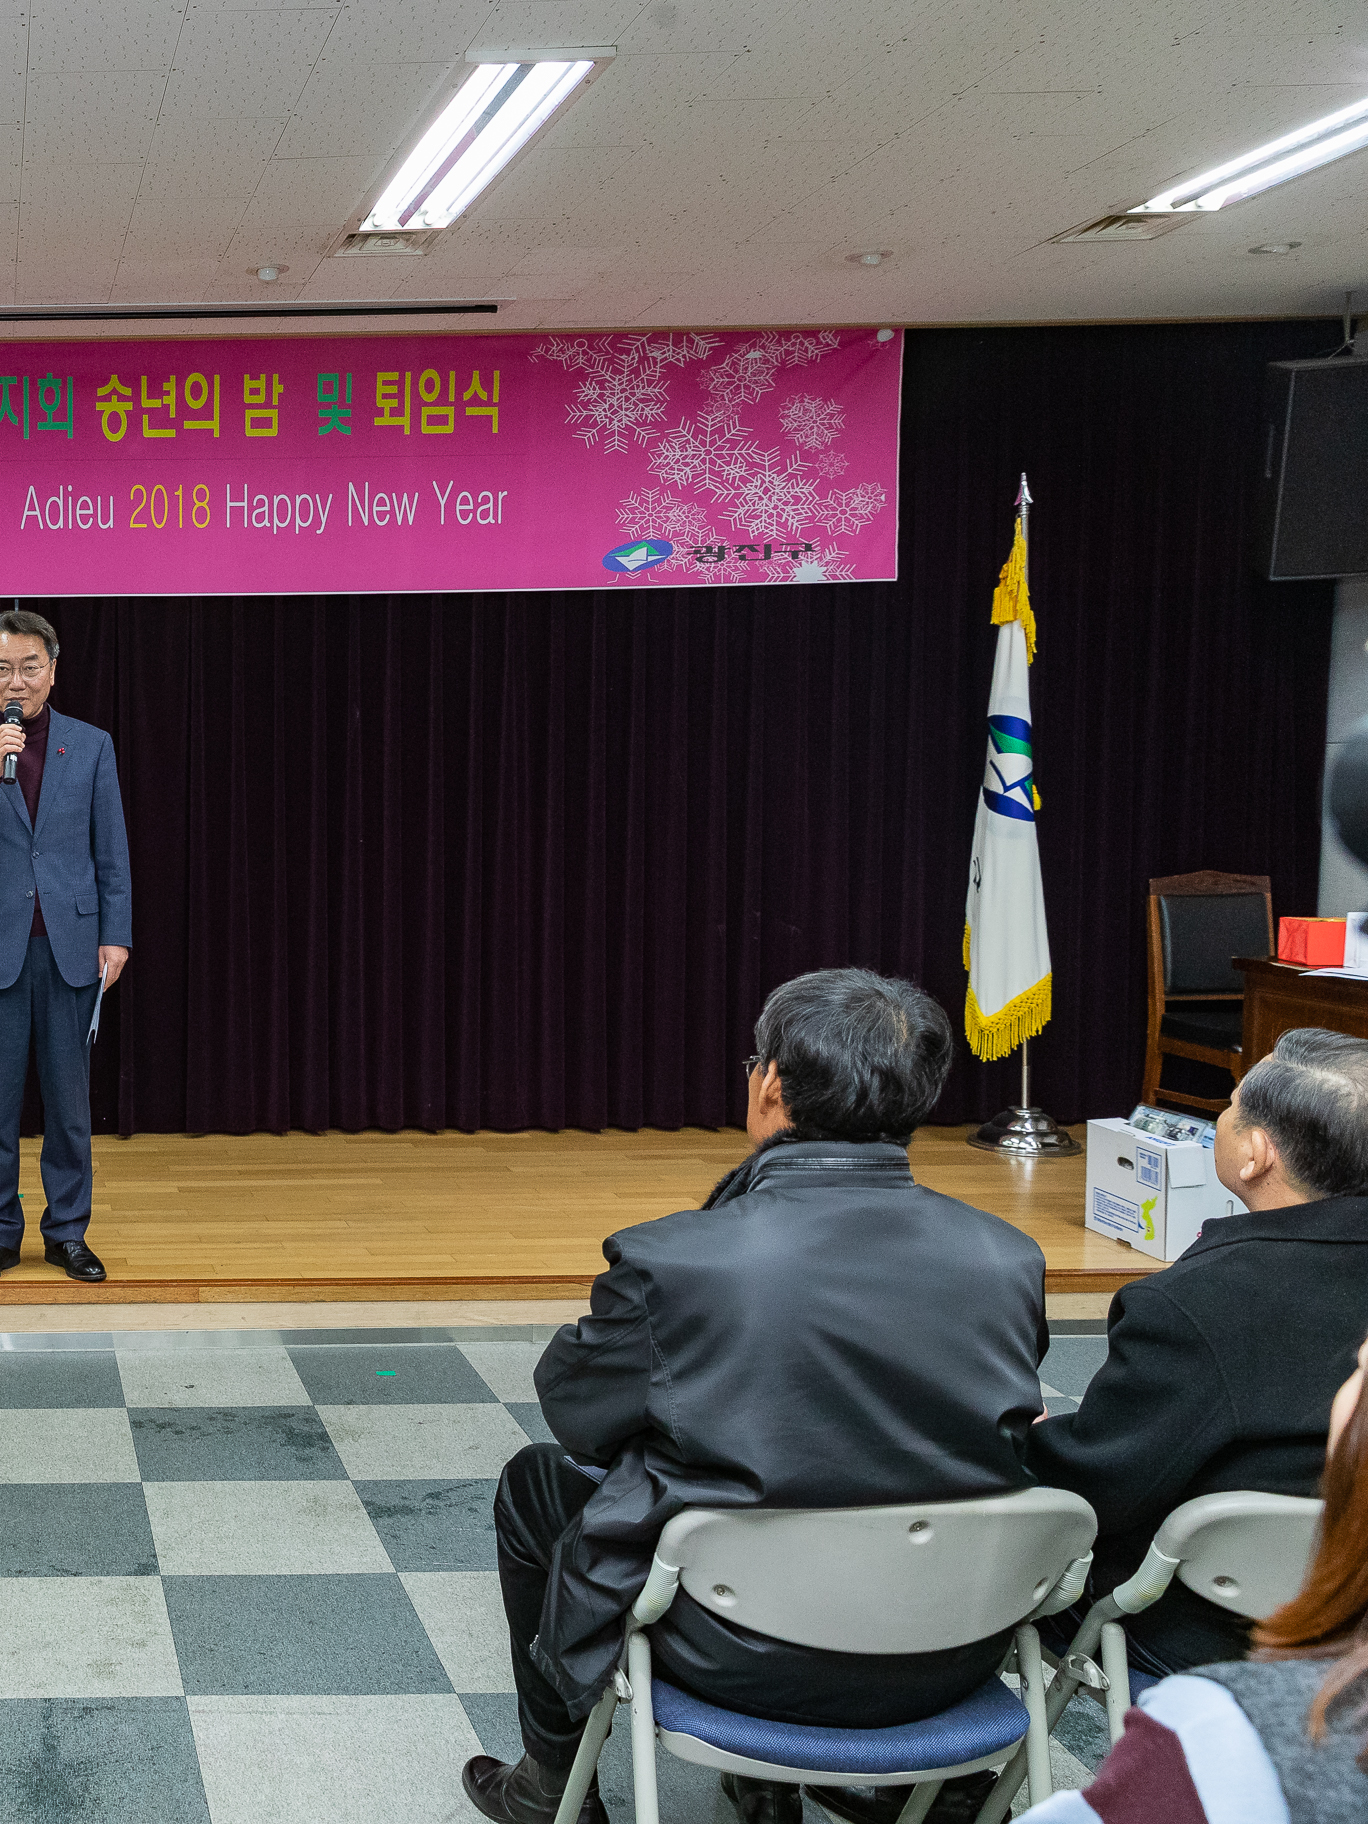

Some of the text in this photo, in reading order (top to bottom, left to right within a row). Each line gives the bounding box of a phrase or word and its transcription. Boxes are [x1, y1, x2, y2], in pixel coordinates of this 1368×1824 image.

[95, 372, 221, 442] 송년의
[243, 373, 284, 438] 밤
[317, 373, 353, 436] 및
[373, 369, 501, 435] 퇴임식
[20, 480, 508, 535] Adieu 2018 Happy New Year
[687, 542, 816, 563] 광진구
